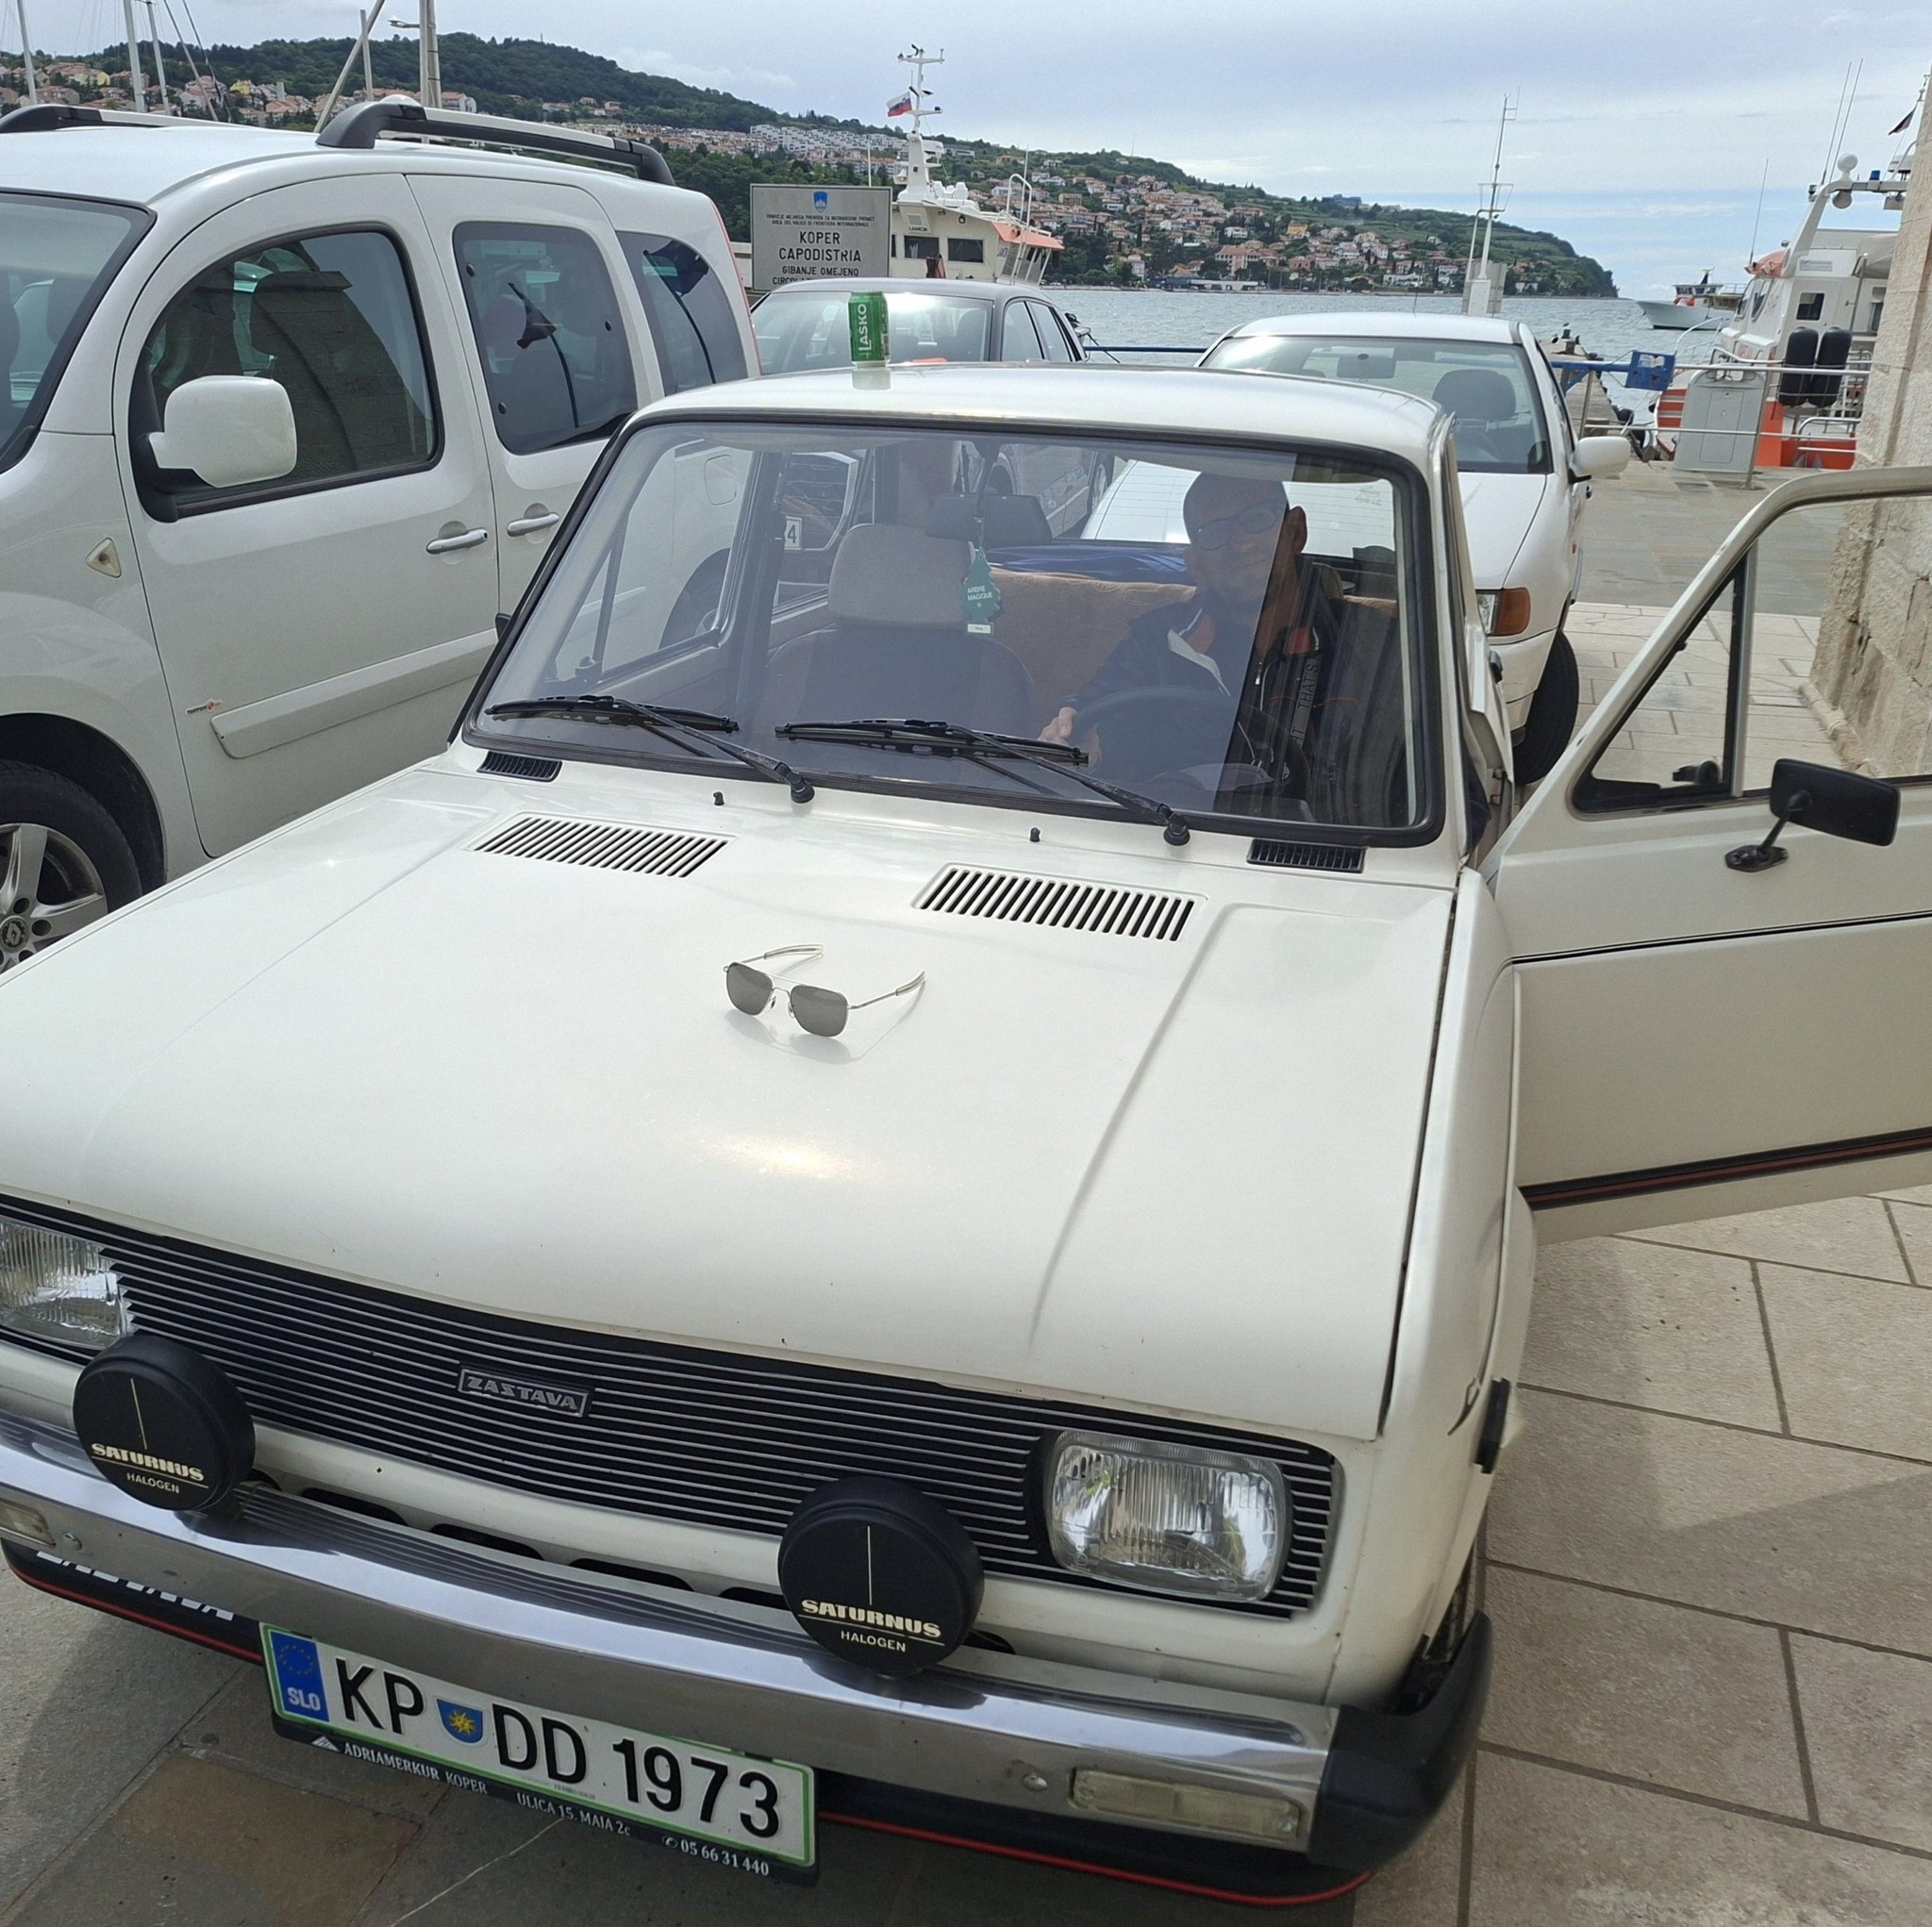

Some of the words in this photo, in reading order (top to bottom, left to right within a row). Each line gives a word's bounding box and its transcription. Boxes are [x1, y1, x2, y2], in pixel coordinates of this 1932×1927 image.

[799, 231, 841, 245] KOPER
[778, 247, 861, 262] CAPODISTRIA
[782, 266, 817, 275] GIBANJE
[821, 267, 859, 277] OMEJENO
[967, 586, 987, 594] ARBRE
[967, 591, 993, 601] MAGIQUE
[1298, 664, 1318, 709] THAT'S
[467, 1376, 578, 1410] ZASTAVA
[92, 1442, 205, 1482] SATURNUS
[126, 1472, 180, 1494] HALOGEN
[801, 1599, 941, 1638] SATURNUS
[841, 1630, 907, 1653] HALOGEN
[287, 1686, 322, 1712] SLO
[335, 1657, 425, 1735] KP
[491, 1703, 588, 1785] DD
[612, 1737, 780, 1838] 1973
[343, 1742, 441, 1783] ADRIAMERKUR
[444, 1770, 489, 1795] KOPER
[516, 1792, 556, 1815] ULICA
[680, 1838, 698, 1855] 05
[701, 1845, 719, 1863] 66
[722, 1850, 740, 1868] 31
[741, 1856, 770, 1876] 440
